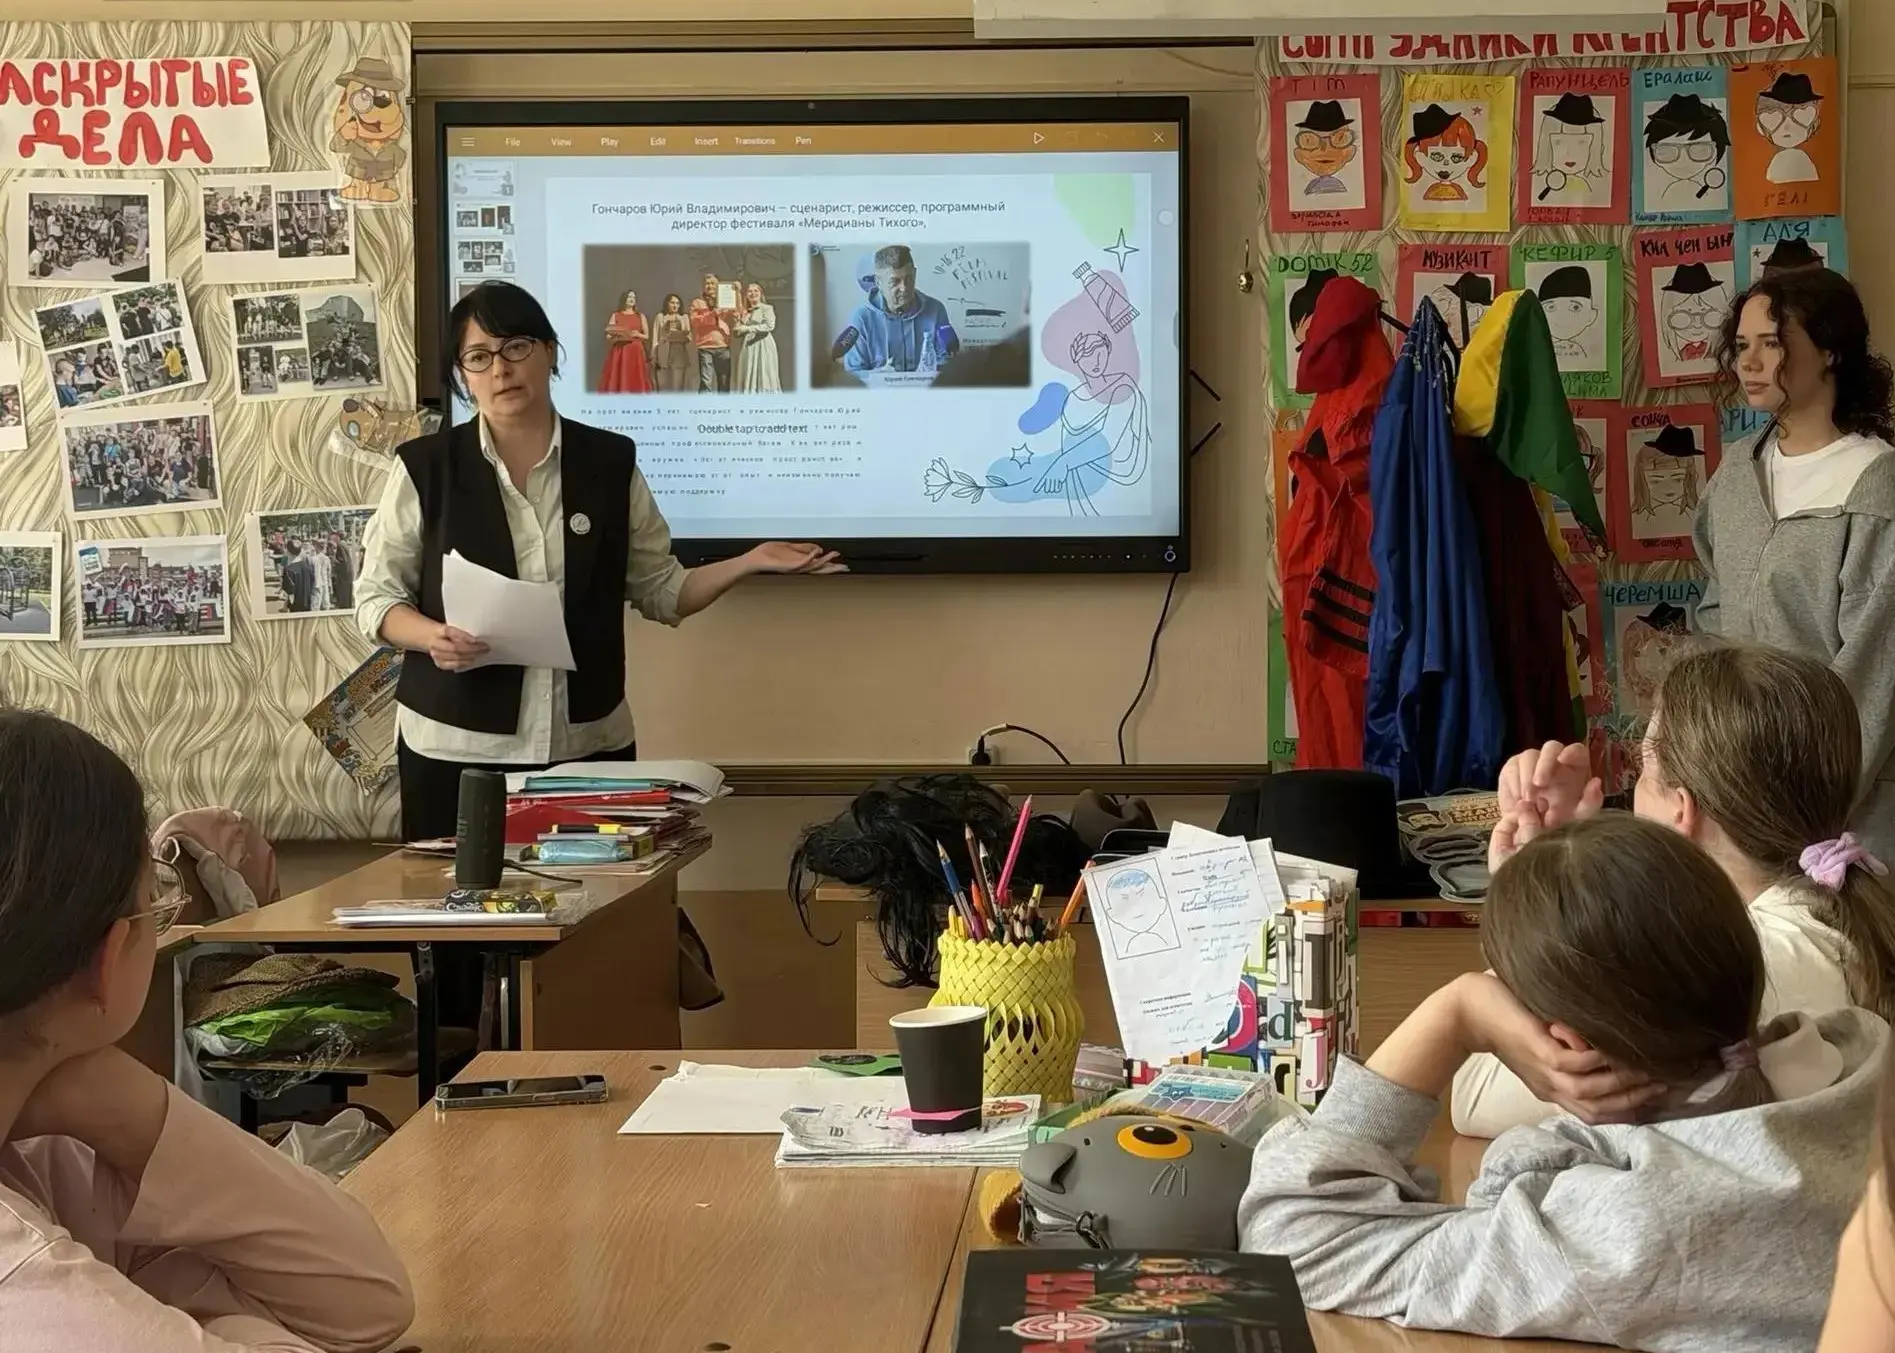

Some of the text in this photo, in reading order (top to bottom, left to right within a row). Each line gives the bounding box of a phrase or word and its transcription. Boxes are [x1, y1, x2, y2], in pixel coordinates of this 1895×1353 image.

[18, 108, 213, 166] ДЕЛА
[505, 137, 521, 147] File
[550, 137, 572, 147] View
[600, 136, 620, 148] Play
[649, 136, 666, 146] Edit
[694, 136, 719, 146] Insert
[795, 135, 812, 145] Pen
[592, 203, 647, 216] Гончаров
[650, 203, 683, 216] Юрий
[686, 203, 776, 216] Владимирович
[790, 203, 855, 215] сценарист,
[857, 203, 919, 215] режиссер,
[921, 201, 1005, 215] программный
[671, 217, 927, 231] директор фестиваля «Меридианы Тихого»,
[1762, 220, 1810, 242] АЛЯ
[698, 424, 734, 434] Double
[735, 424, 752, 436] tap
[754, 424, 767, 434] to
[767, 423, 787, 434] add
[788, 424, 808, 434] text
